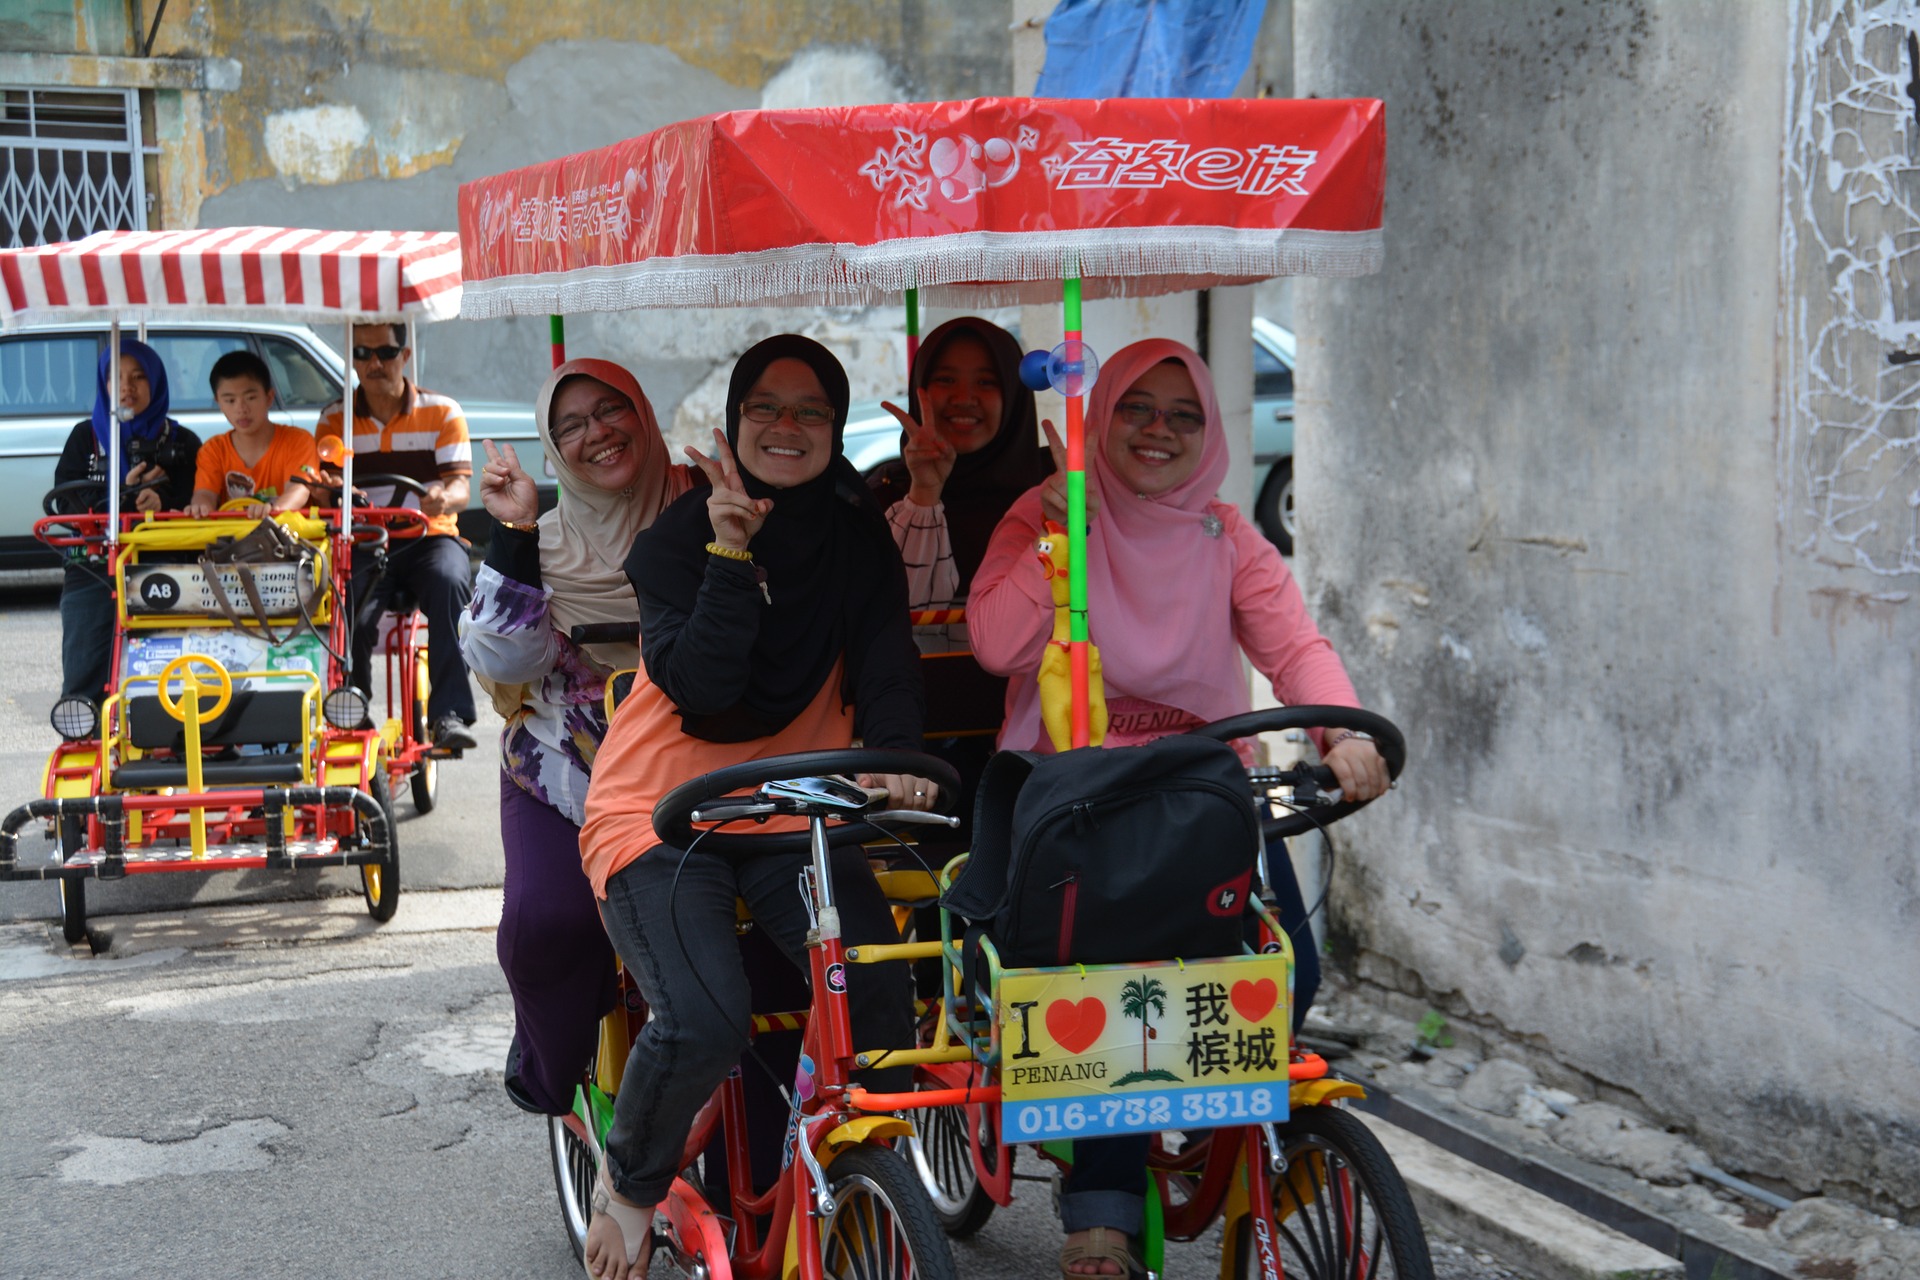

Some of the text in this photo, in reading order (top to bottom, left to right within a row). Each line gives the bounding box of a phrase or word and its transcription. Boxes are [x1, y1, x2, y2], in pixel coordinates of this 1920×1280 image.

[148, 583, 172, 598] A8
[1185, 982, 1230, 1028] 我
[1010, 1000, 1040, 1060] I
[1186, 1026, 1278, 1078] 槟城
[1011, 1061, 1108, 1085] PENANG
[1018, 1088, 1273, 1134] 016-732 3318
